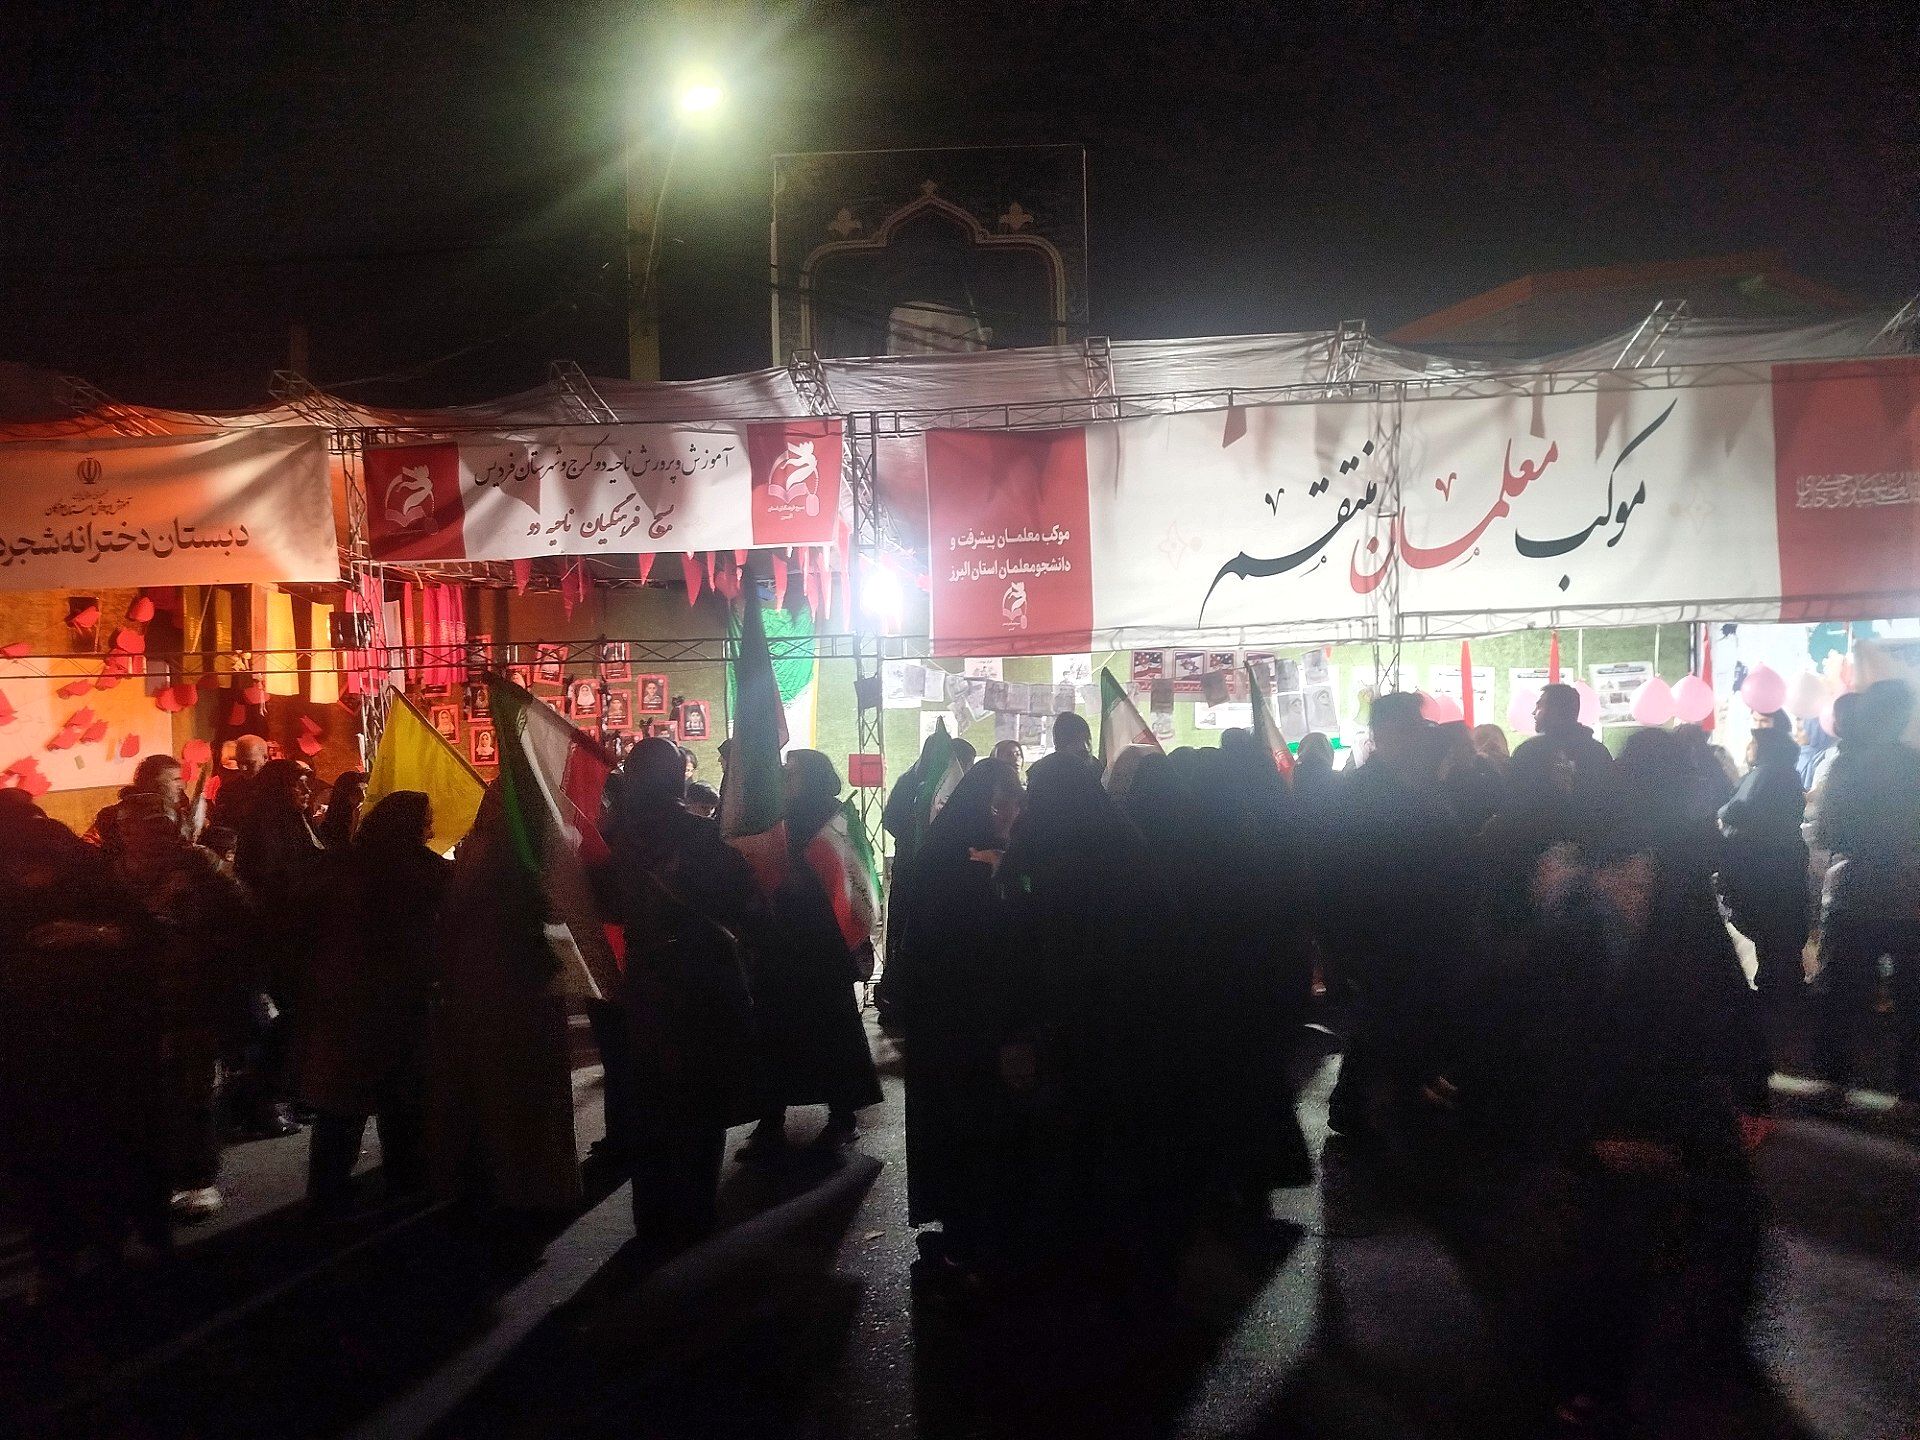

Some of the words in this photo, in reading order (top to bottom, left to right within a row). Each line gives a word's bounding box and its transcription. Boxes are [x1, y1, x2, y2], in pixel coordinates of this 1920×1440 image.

[474, 451, 515, 488] فردیس
[566, 432, 609, 480] کرج
[682, 443, 735, 476] آموزش
[1514, 397, 1678, 592] موکب
[526, 522, 541, 536] دو
[545, 508, 575, 547] ناحیه
[580, 492, 640, 545] فرهنگیان
[1350, 437, 1559, 594] معلمان
[0, 527, 60, 567] شجر
[60, 520, 151, 563] دخترانه
[153, 517, 249, 559] دبستان
[949, 534, 957, 551] و
[957, 527, 996, 550] پیشرفت
[997, 527, 1040, 549] معلمان
[1041, 524, 1070, 546] موکب
[948, 560, 971, 583] البرز
[971, 559, 998, 581] استان
